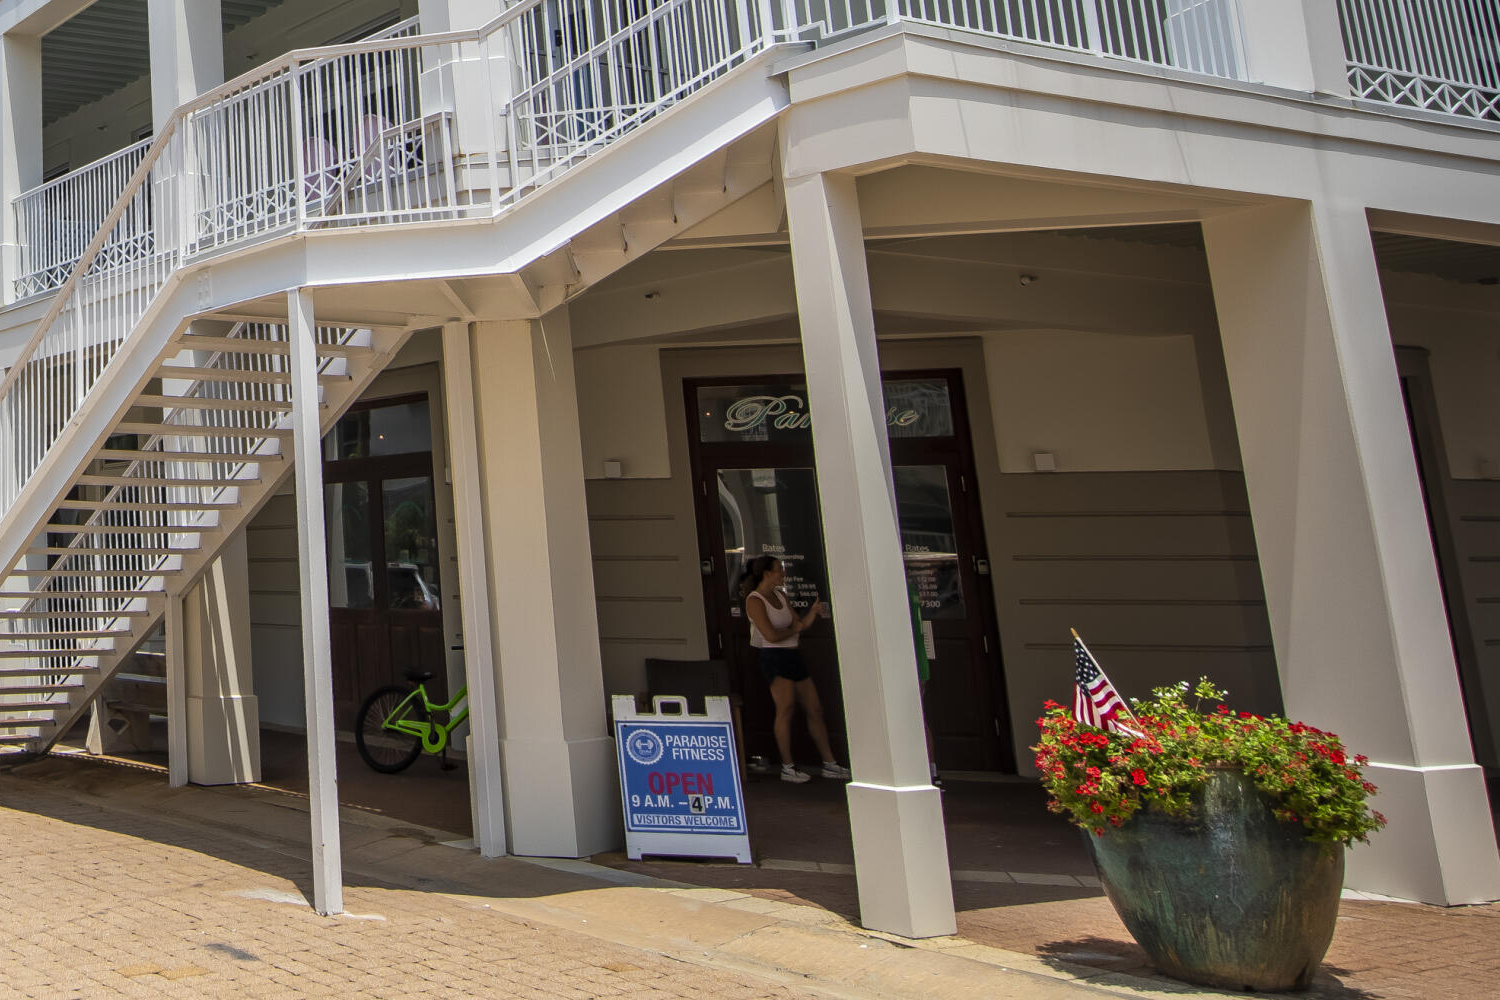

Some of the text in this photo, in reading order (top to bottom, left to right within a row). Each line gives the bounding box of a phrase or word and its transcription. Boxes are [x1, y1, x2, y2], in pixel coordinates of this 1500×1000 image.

[762, 543, 785, 553] Rates
[905, 544, 930, 552] Rates
[920, 600, 941, 608] 7300
[665, 735, 728, 748] PARADISE
[672, 748, 725, 761] FITNESS
[647, 771, 714, 795] OPEN
[631, 795, 641, 807] 9
[644, 795, 674, 807] A.M.
[692, 797, 703, 812] 4
[704, 796, 735, 809] P.M.
[636, 814, 735, 827] VISITORS WELCOME
